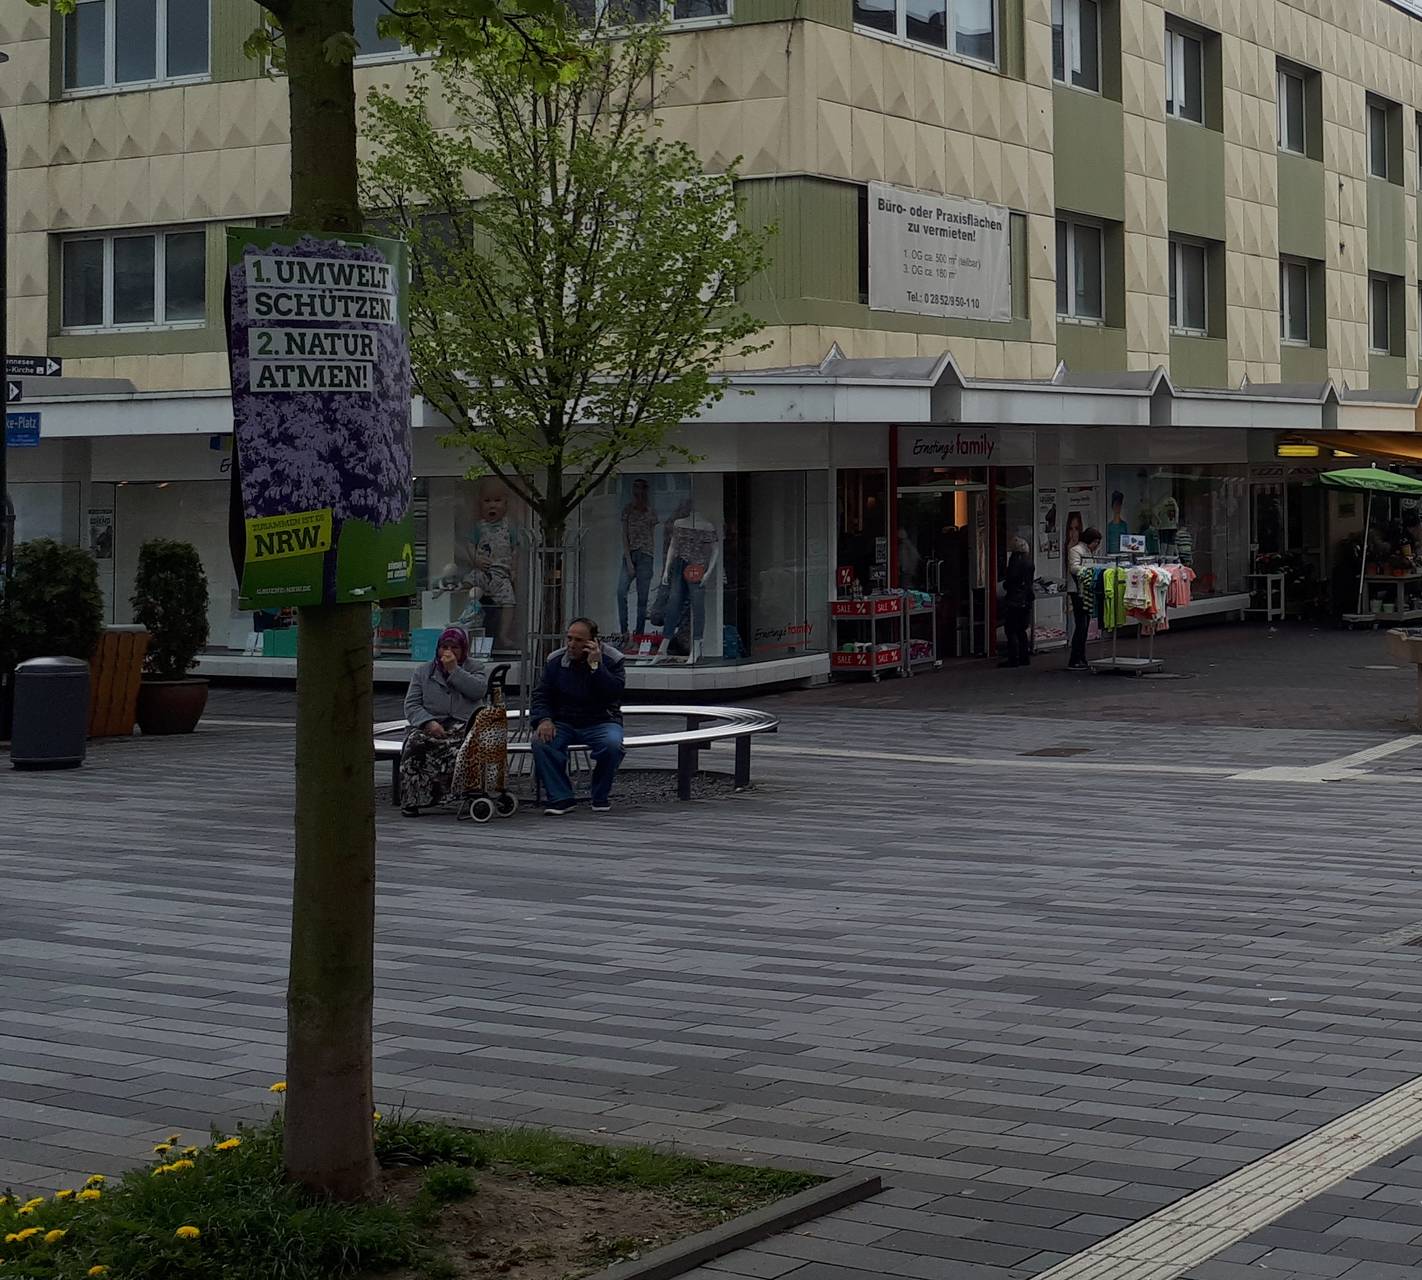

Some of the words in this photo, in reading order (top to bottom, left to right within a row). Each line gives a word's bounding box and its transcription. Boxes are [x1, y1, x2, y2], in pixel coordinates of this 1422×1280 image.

[878, 198, 906, 214] Büro-
[909, 206, 933, 219] oder
[936, 208, 1002, 231] Praxisflächen
[907, 222, 919, 233] zu
[923, 225, 976, 242] vermieten!
[911, 249, 923, 261] OG
[252, 259, 272, 284] 1.
[274, 260, 390, 290] UMWELT
[911, 264, 923, 275] OG
[254, 288, 395, 321] SCHÜTZEN.
[256, 331, 280, 356] 2.
[284, 332, 375, 357] NATUR
[256, 364, 369, 389] ATMEN!
[913, 438, 955, 460] Ernsting's
[956, 432, 995, 460] family
[254, 524, 326, 557] NRW.
[836, 604, 853, 613] SALE
[877, 602, 890, 612] SALE
[836, 655, 853, 665] SALE
[878, 654, 889, 664] SALE
